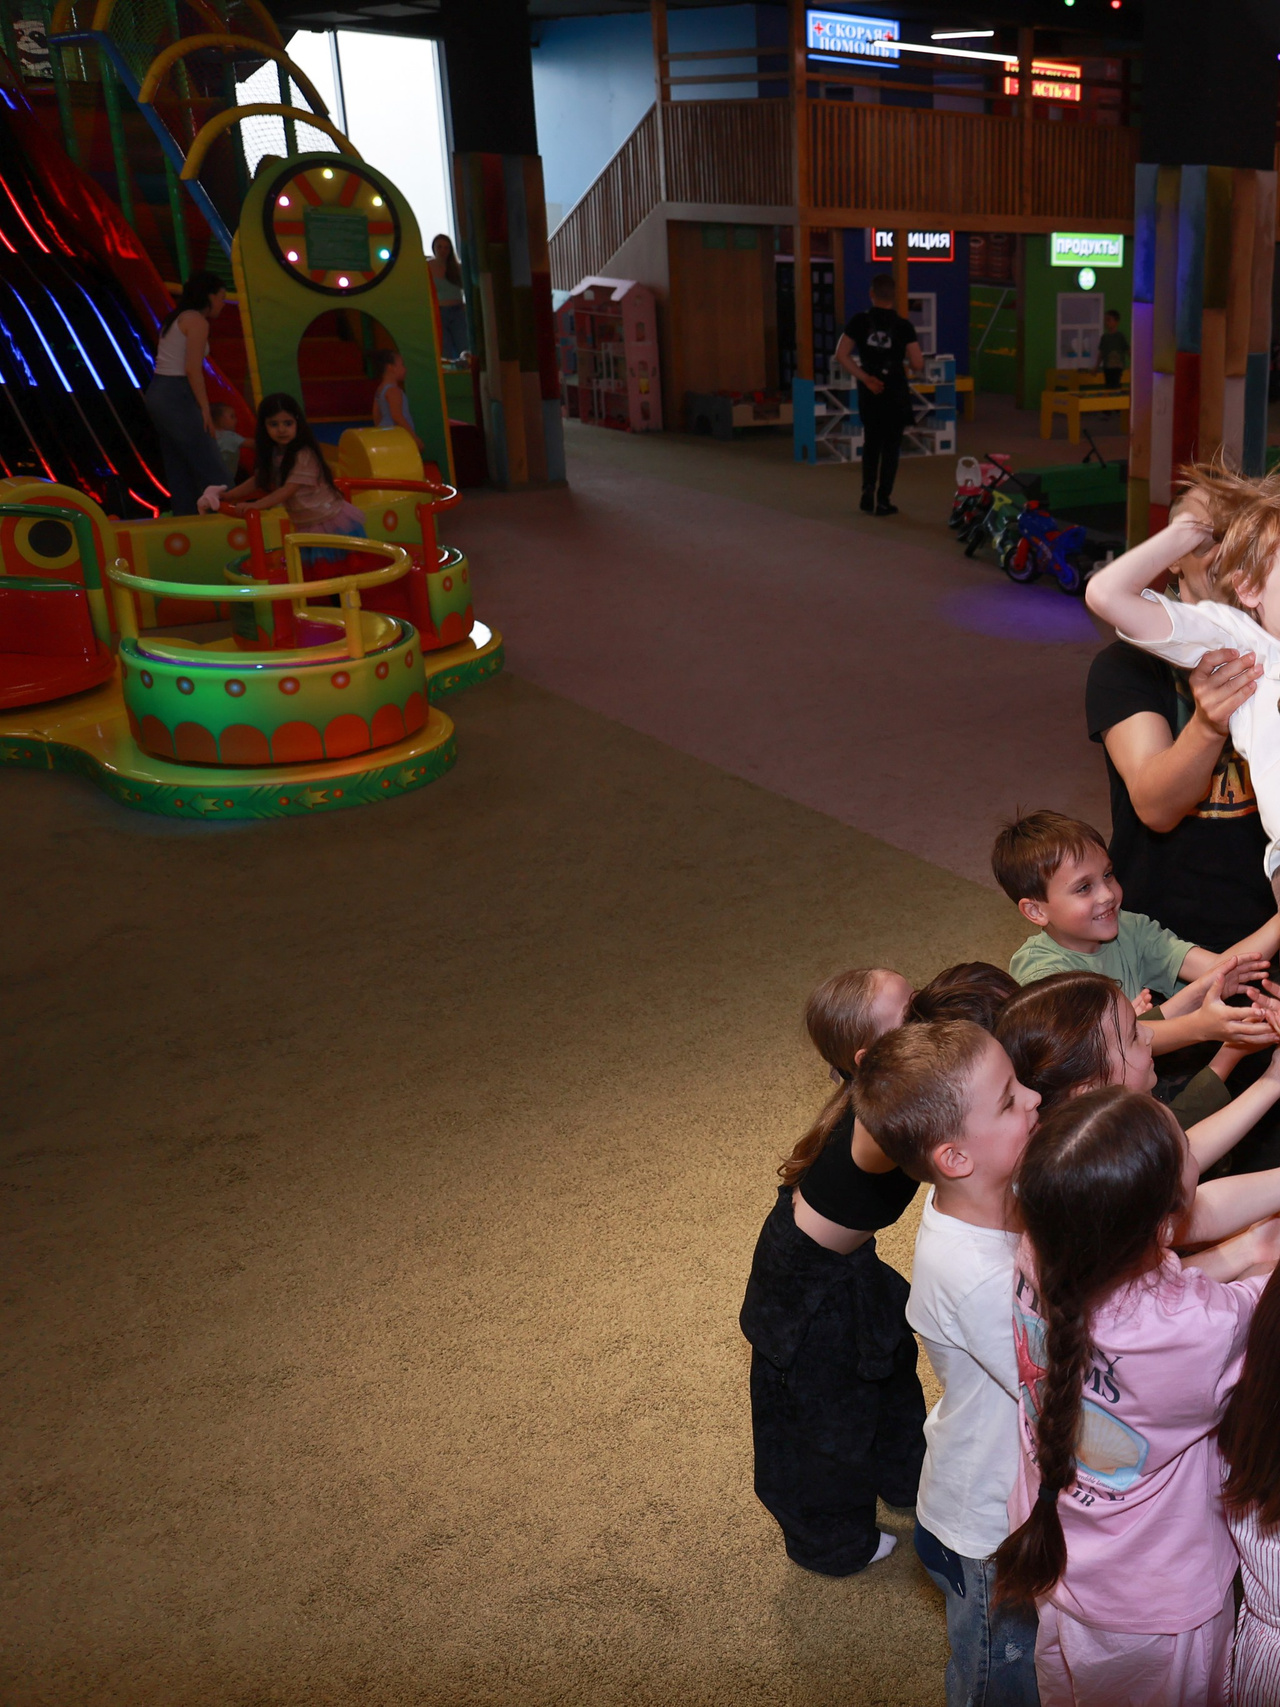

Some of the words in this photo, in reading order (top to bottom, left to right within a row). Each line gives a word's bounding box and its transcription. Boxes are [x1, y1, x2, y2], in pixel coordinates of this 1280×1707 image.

[825, 22, 883, 41] СКОРАЯ
[875, 231, 951, 250] ПОИЦИЯ
[1056, 238, 1120, 256] ПРОДУКТЫ
